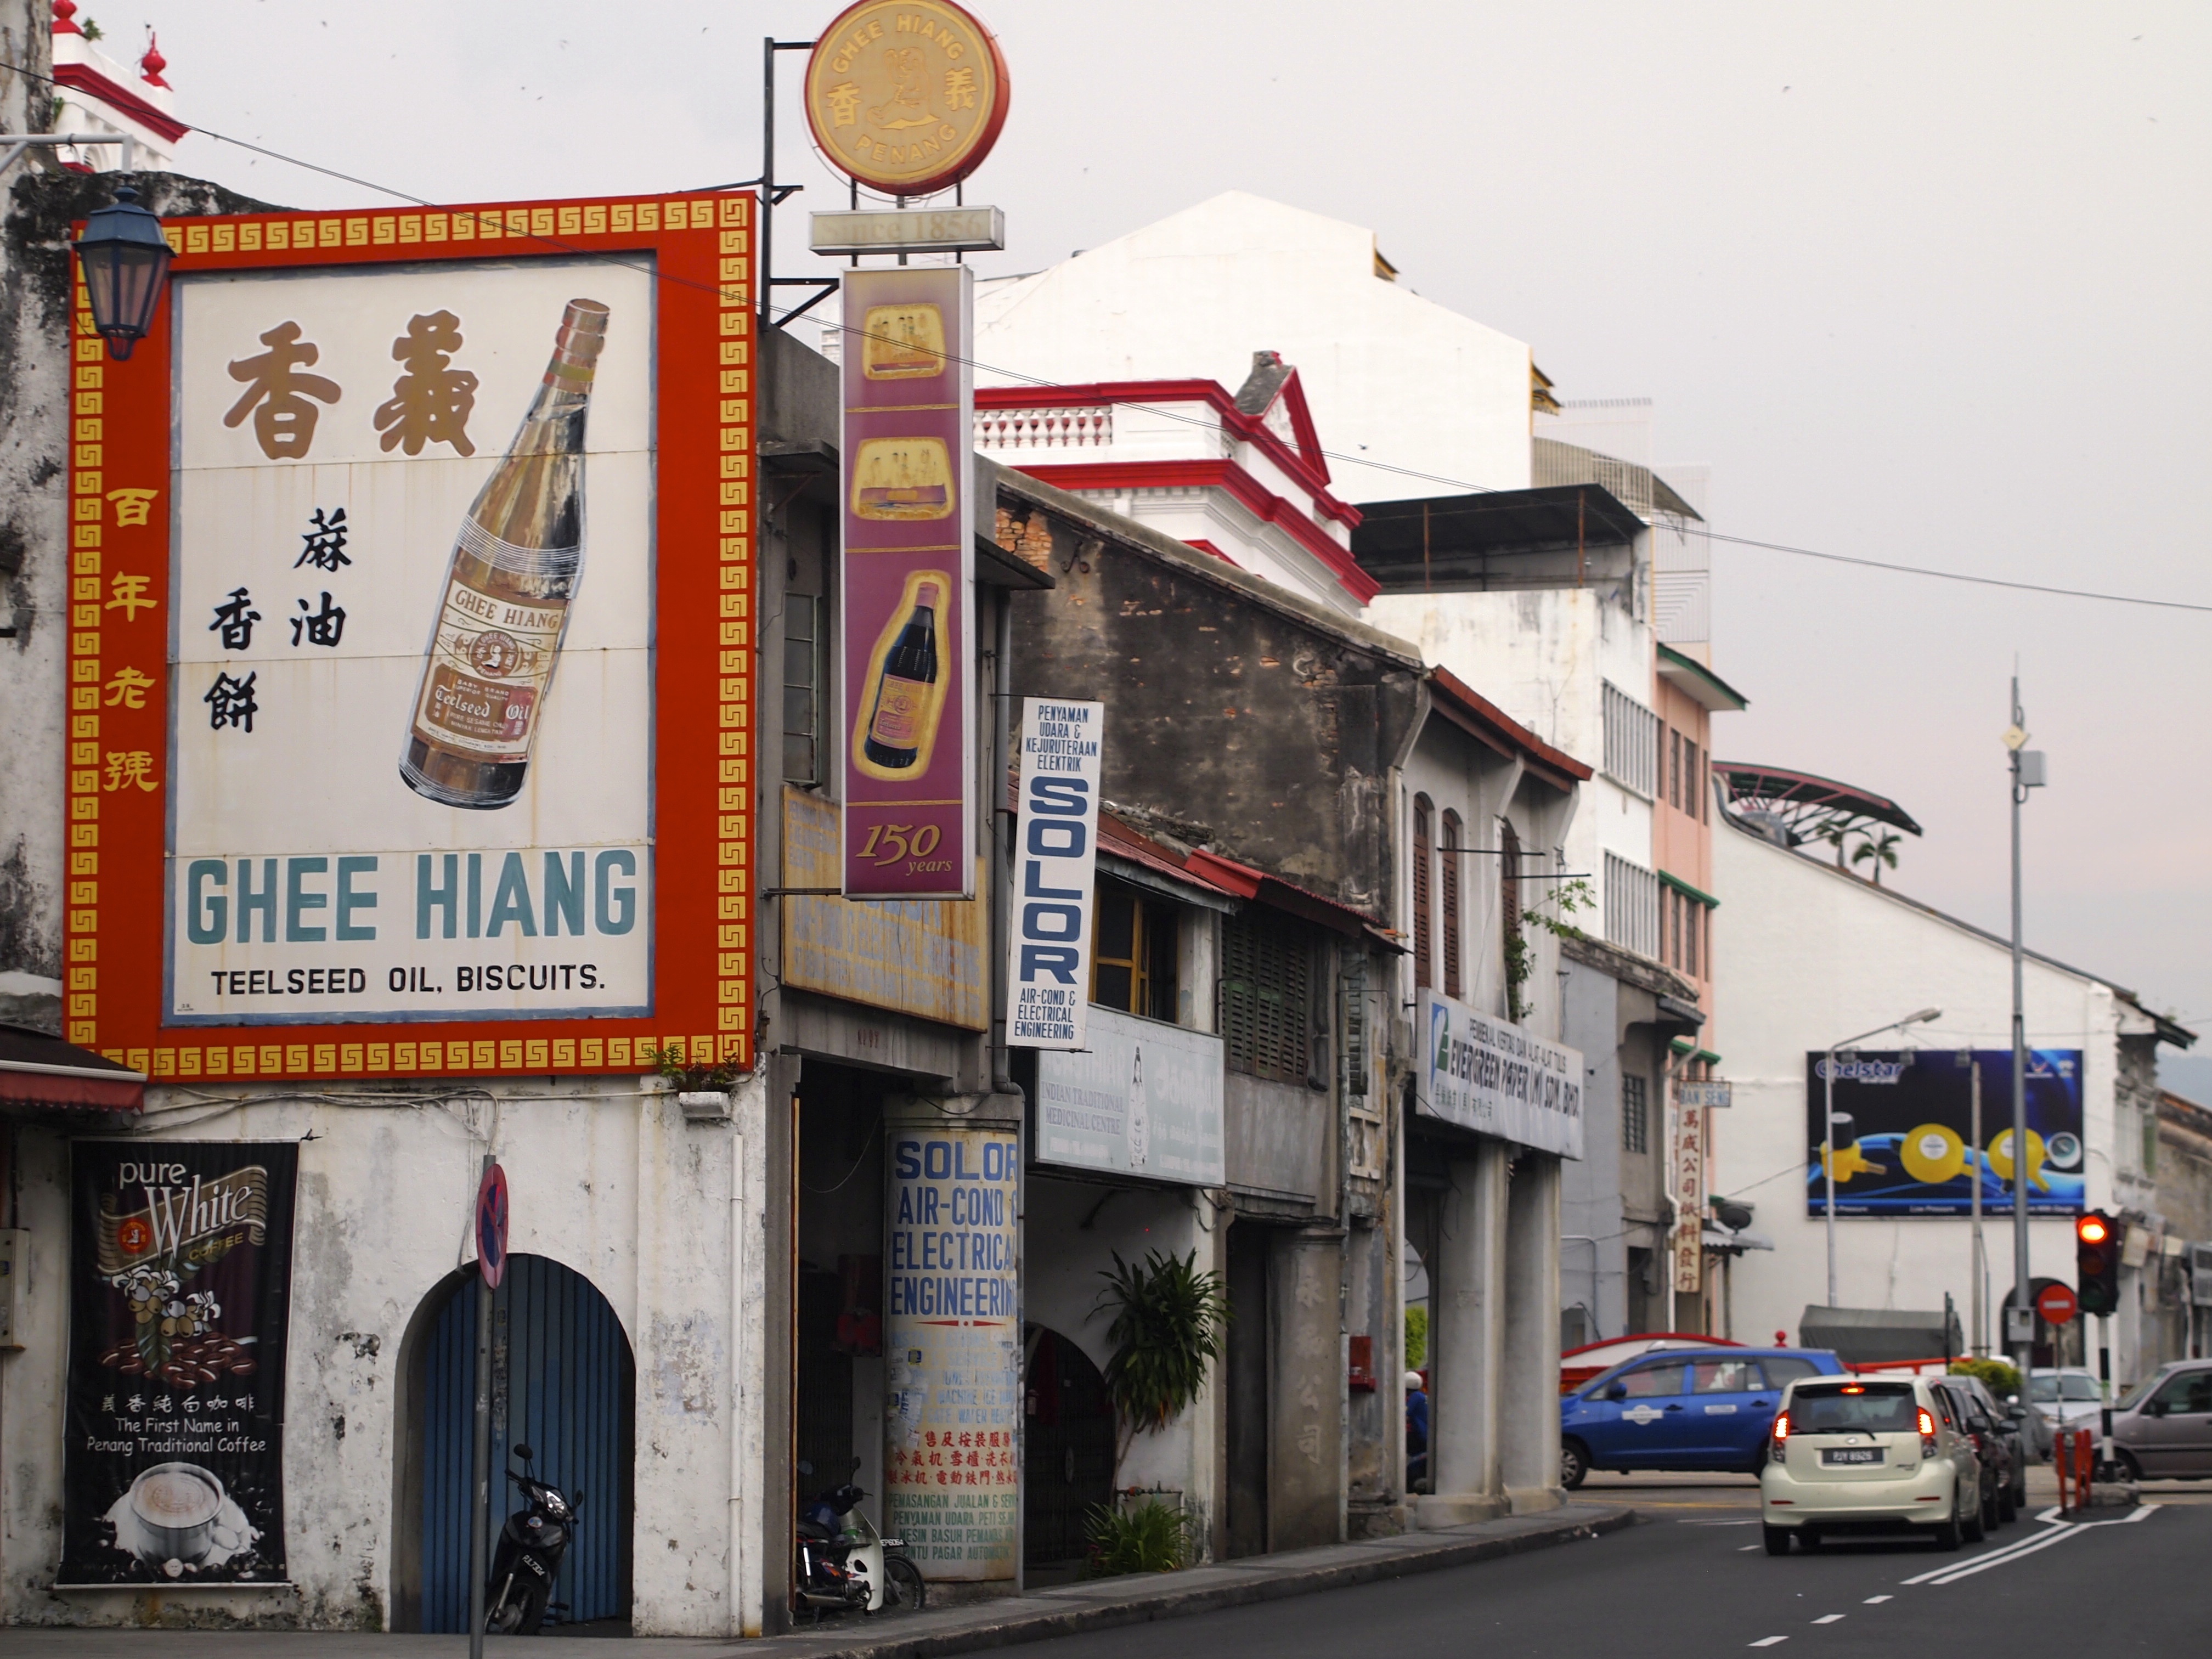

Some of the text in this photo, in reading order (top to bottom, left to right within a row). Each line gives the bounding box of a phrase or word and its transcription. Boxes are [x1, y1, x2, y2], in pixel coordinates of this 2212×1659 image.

[831, 14, 964, 74] GHEE HIANG
[854, 124, 956, 165] PENANG
[914, 213, 982, 240] 1856
[456, 589, 558, 629] GHEE HIANG
[435, 684, 490, 718] Teelseed
[505, 703, 529, 720] Oil
[1038, 705, 1088, 724] PENYAMAN
[1039, 722, 1080, 739] UDARA &
[1026, 737, 1097, 757] KEJURUTERAAN
[1037, 754, 1082, 772] ELEKTRIK
[855, 824, 943, 867] 150
[906, 858, 952, 877] years
[1020, 776, 1088, 984] SOLOR
[187, 850, 637, 945] GHEE HIANG
[211, 963, 606, 996] TEELSEED OIL, BISCUITS.
[1020, 988, 1076, 1006] AIR-COND &
[1018, 1005, 1073, 1023] ELECTRICAL
[1014, 1021, 1074, 1040] ENGINEERING
[1450, 1039, 1500, 1091] EVERGREEN
[1042, 1080, 1124, 1114] INDIAN TRADITIONAL
[1045, 1105, 1120, 1136] MEDICINAL CENTRE
[119, 1161, 187, 1189] pure
[144, 1173, 253, 1260] White
[898, 1186, 1003, 1227] AIR-COND
[188, 1232, 244, 1261] COFFEE
[115, 1417, 240, 1433] The First Name in
[87, 1436, 267, 1457] Penang Traditional Coffee
[889, 1494, 949, 1509] PEMASANGAN
[954, 1493, 989, 1509] JUALAN
[893, 1511, 941, 1526] PENYAMAN
[945, 1511, 974, 1526] UDARA
[978, 1511, 996, 1526] PETI
[899, 1528, 927, 1543] MESIN
[931, 1528, 962, 1543] BASUH
[932, 1545, 962, 1560] PAGAR
